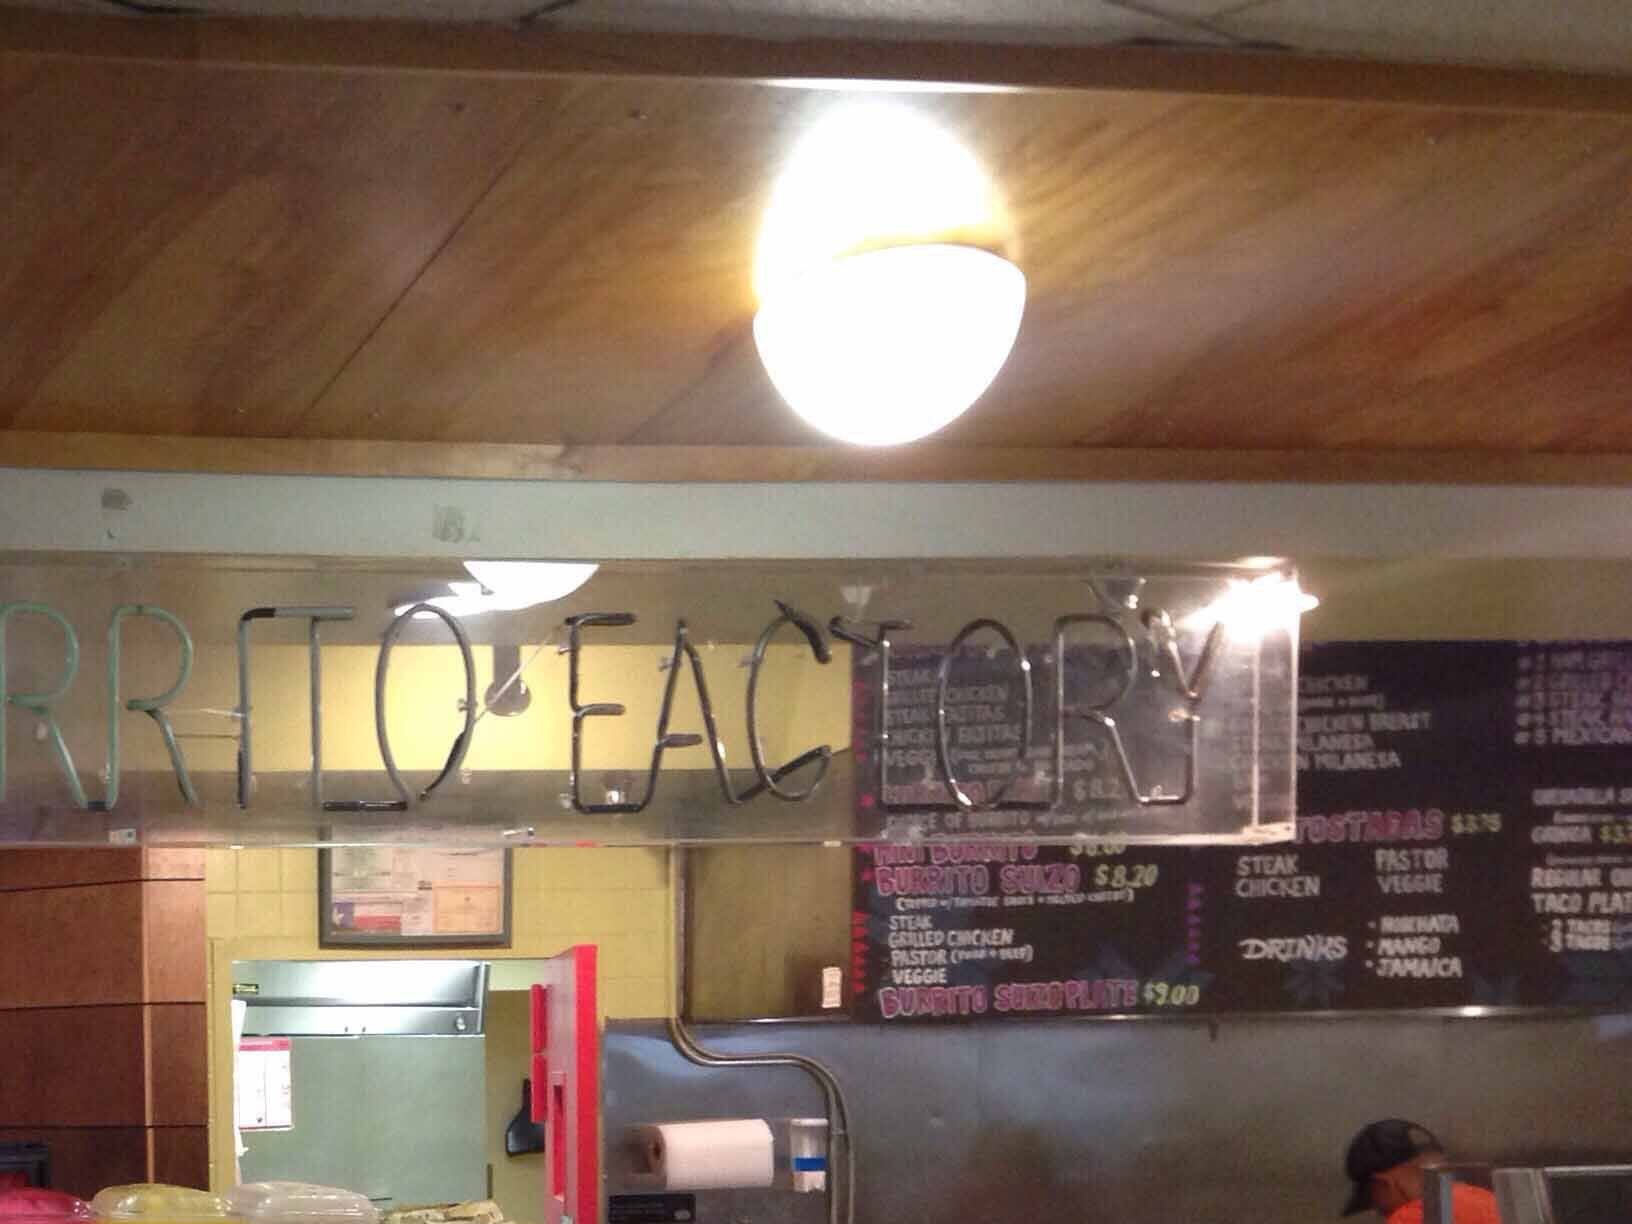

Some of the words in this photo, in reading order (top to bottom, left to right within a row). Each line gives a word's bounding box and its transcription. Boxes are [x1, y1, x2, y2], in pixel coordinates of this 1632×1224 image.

[563, 601, 1226, 813] FACTORY
[1236, 853, 1300, 876] STEAK
[874, 865, 989, 897] BURRITO
[1234, 875, 1321, 899] CHICKEN
[1236, 934, 1349, 962] DRINKS
[1375, 956, 1464, 979] JAMAICA
[878, 984, 990, 1019] BURRITO
